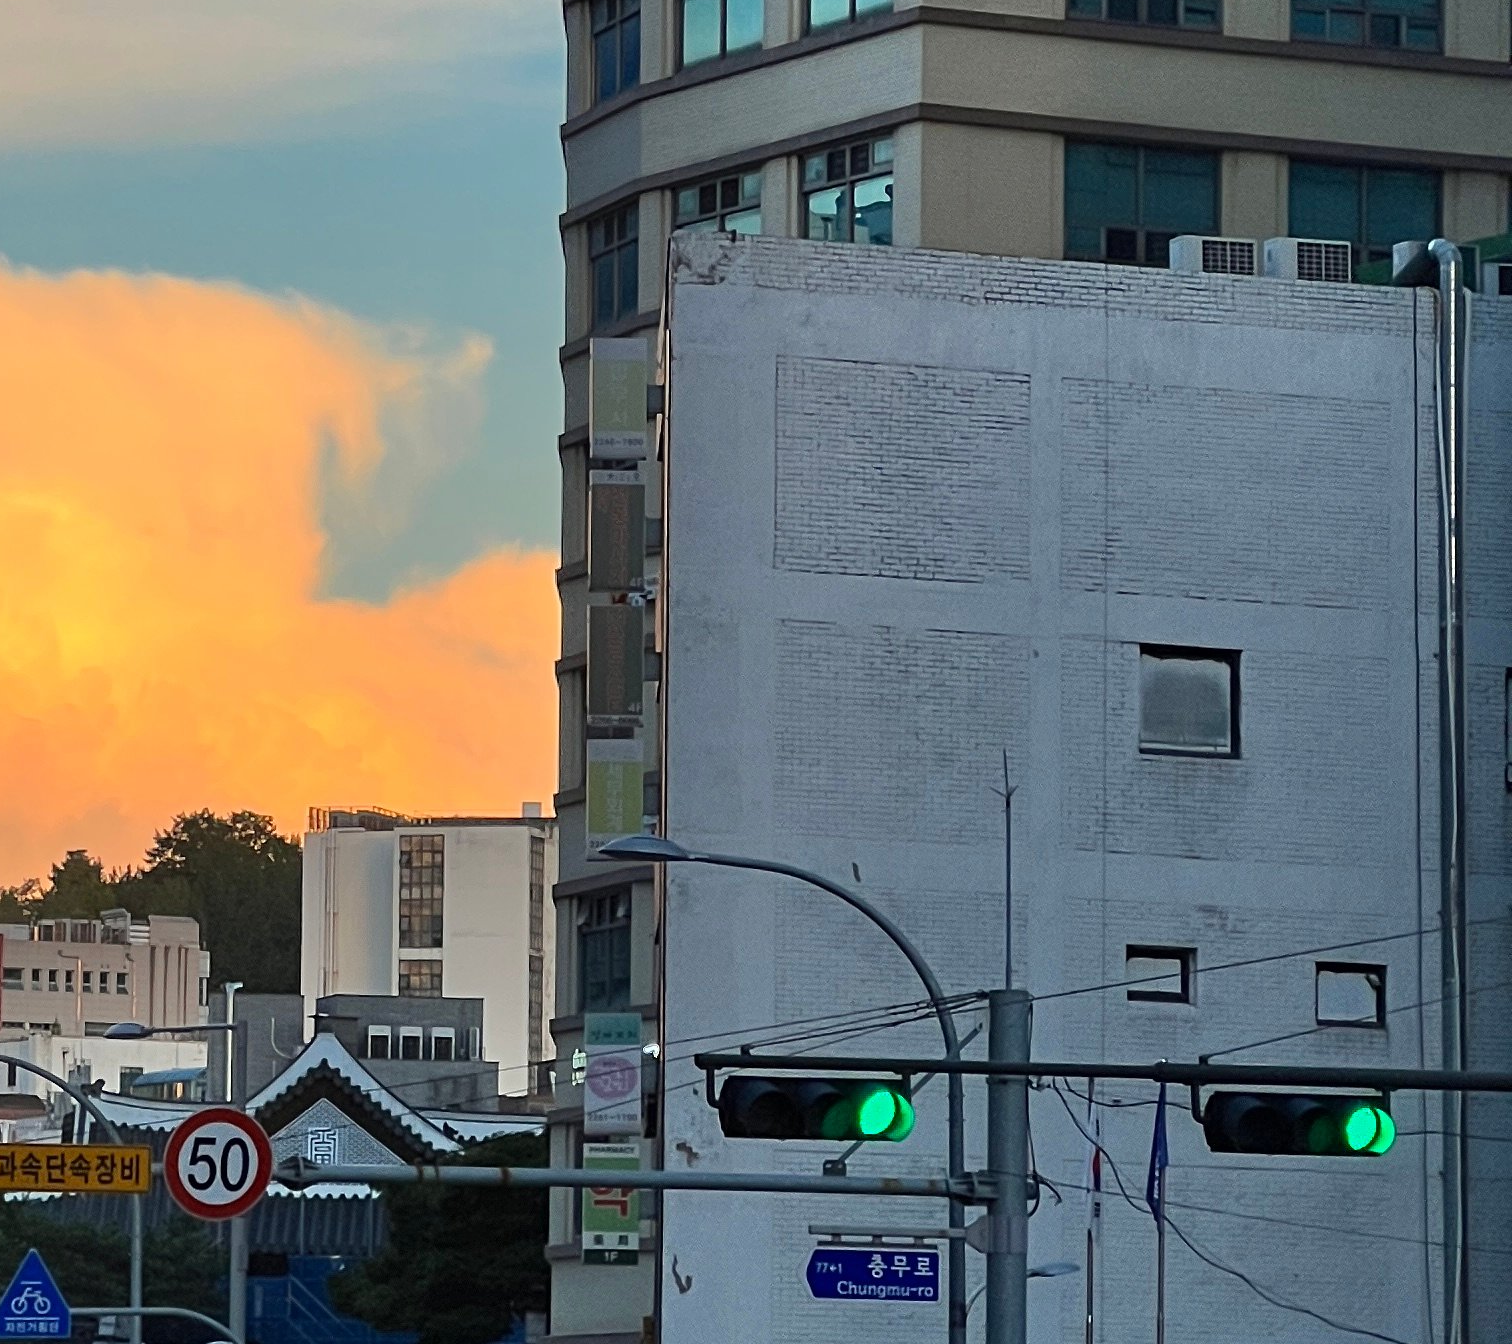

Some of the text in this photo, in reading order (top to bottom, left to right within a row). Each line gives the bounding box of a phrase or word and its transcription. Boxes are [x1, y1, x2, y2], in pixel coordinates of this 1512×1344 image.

[187, 1136, 251, 1193] 50
[867, 1254, 934, 1278] 충무로
[837, 1280, 934, 1298] Chungmu-ro
